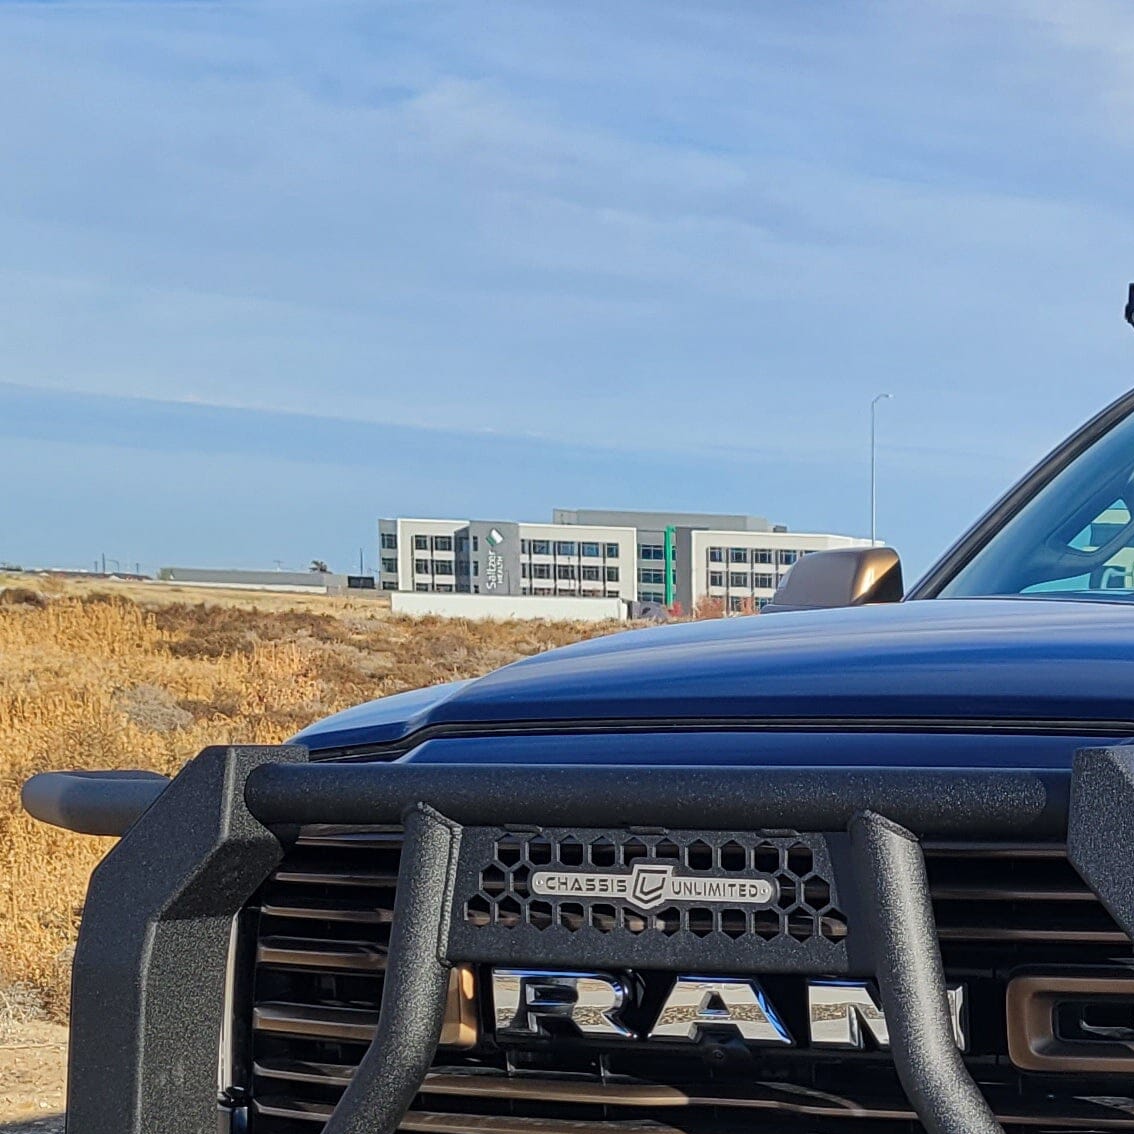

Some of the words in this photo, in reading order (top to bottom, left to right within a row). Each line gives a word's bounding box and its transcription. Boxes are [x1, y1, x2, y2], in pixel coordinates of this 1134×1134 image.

[486, 549, 496, 590] Saltzer
[545, 876, 627, 894] CHASSIS
[671, 880, 759, 898] UNLIMITED
